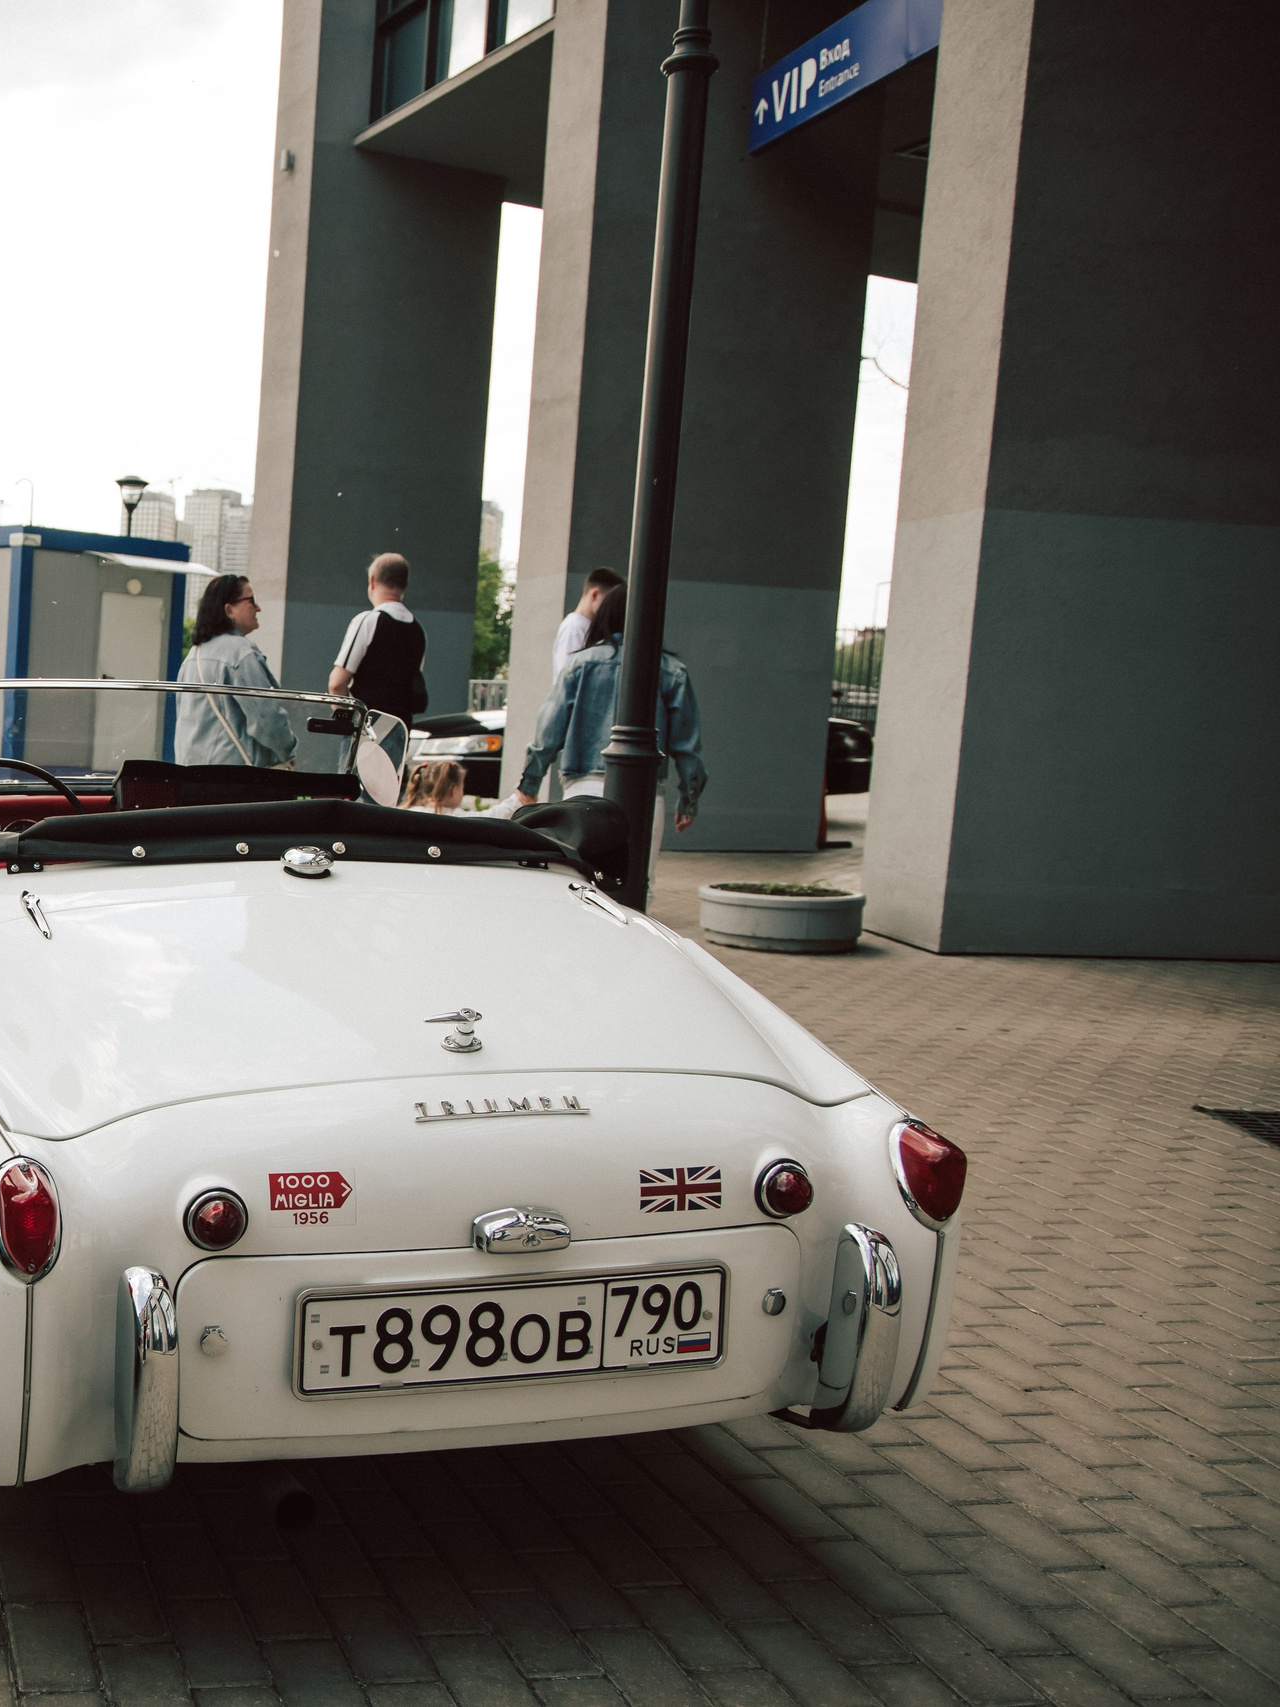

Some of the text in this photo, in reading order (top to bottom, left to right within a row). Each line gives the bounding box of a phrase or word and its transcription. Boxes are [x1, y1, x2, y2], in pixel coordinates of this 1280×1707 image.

[819, 38, 850, 70] Вход
[772, 58, 817, 122] VIP
[818, 62, 860, 97] Entrance
[414, 1095, 582, 1119] TRIUMPH
[277, 1174, 330, 1189] 1000
[274, 1192, 335, 1208] MIGLIA
[292, 1211, 329, 1225] 1956
[610, 1280, 703, 1338] 790
[629, 1336, 676, 1358] RUS
